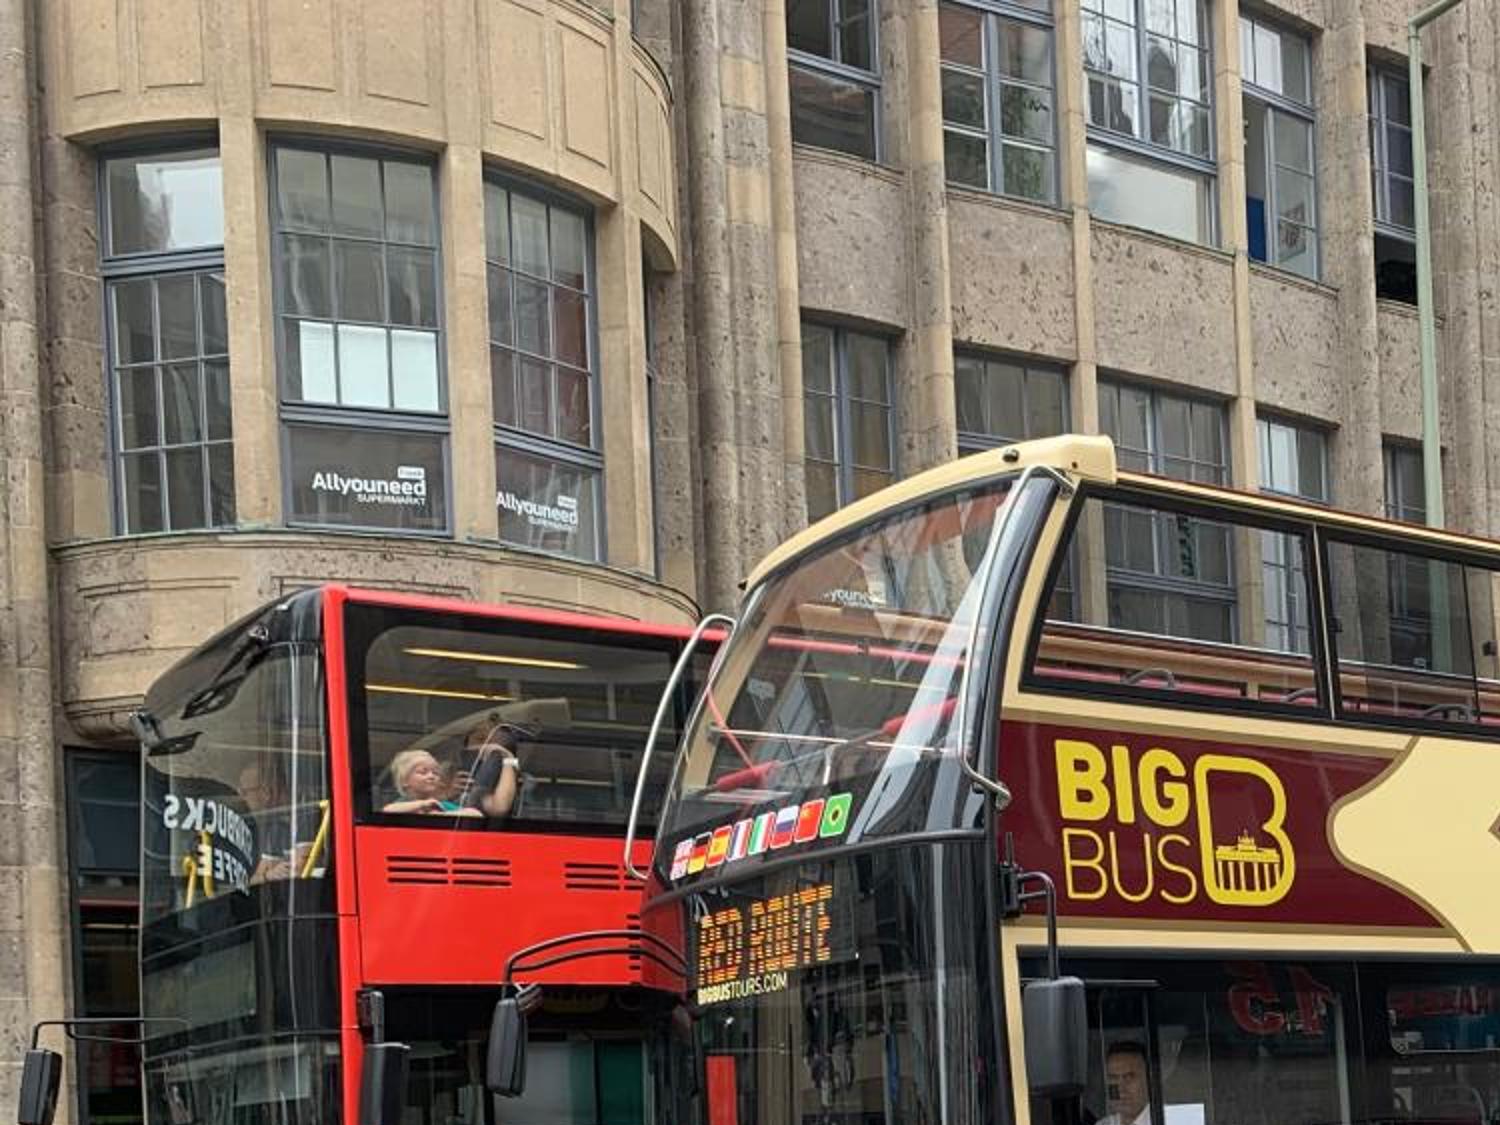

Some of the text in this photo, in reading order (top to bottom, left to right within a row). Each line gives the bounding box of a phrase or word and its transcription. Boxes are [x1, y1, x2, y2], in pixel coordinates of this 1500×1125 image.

[311, 471, 427, 497] Allyouneed
[496, 490, 578, 526] Allyouneed
[1055, 739, 1190, 827] BIG
[1063, 828, 1197, 903] BUS
